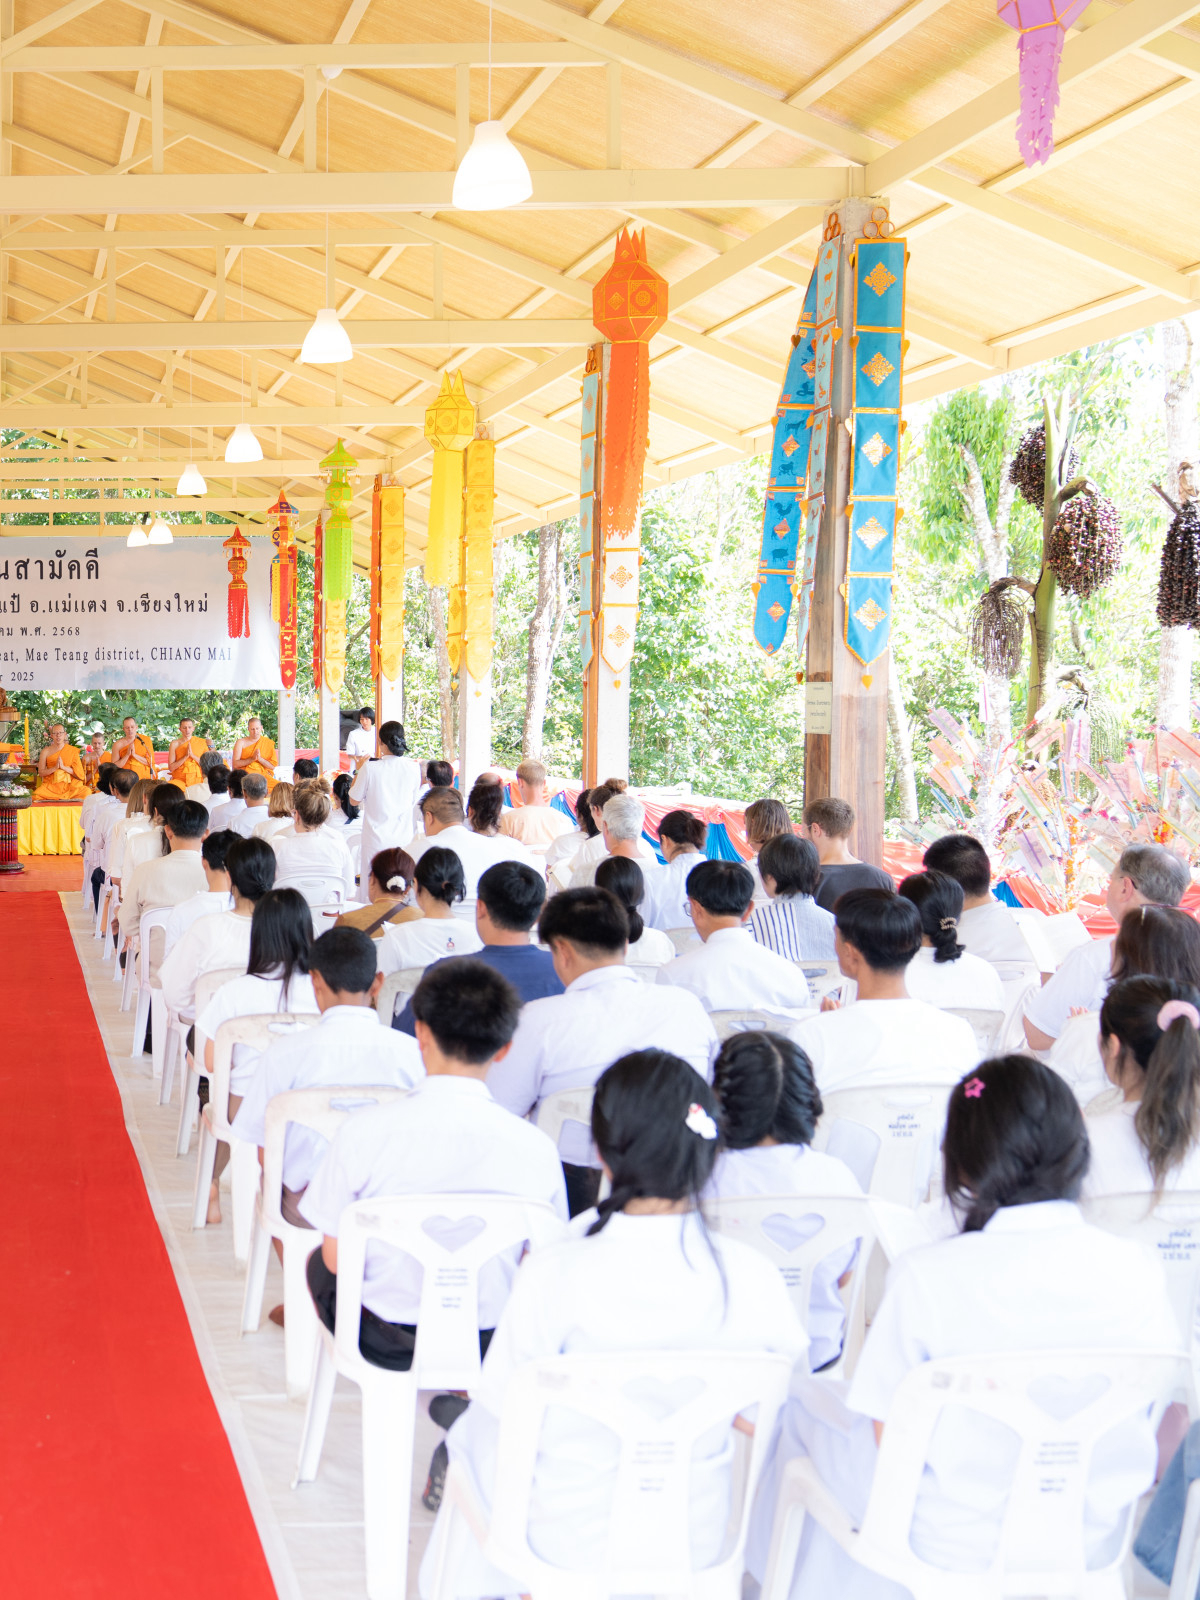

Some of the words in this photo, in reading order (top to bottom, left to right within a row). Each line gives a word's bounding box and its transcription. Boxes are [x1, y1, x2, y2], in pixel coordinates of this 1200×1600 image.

[116, 592, 208, 614] จ.เชียงใหม่
[19, 625, 46, 637] พ.ศ.
[52, 626, 81, 637] 2568
[25, 647, 49, 662] Mae
[54, 647, 89, 665] Teang
[94, 646, 145, 663] district,
[150, 646, 201, 661] CHIANG
[207, 646, 232, 661] MAI
[10, 671, 35, 682] 2025
